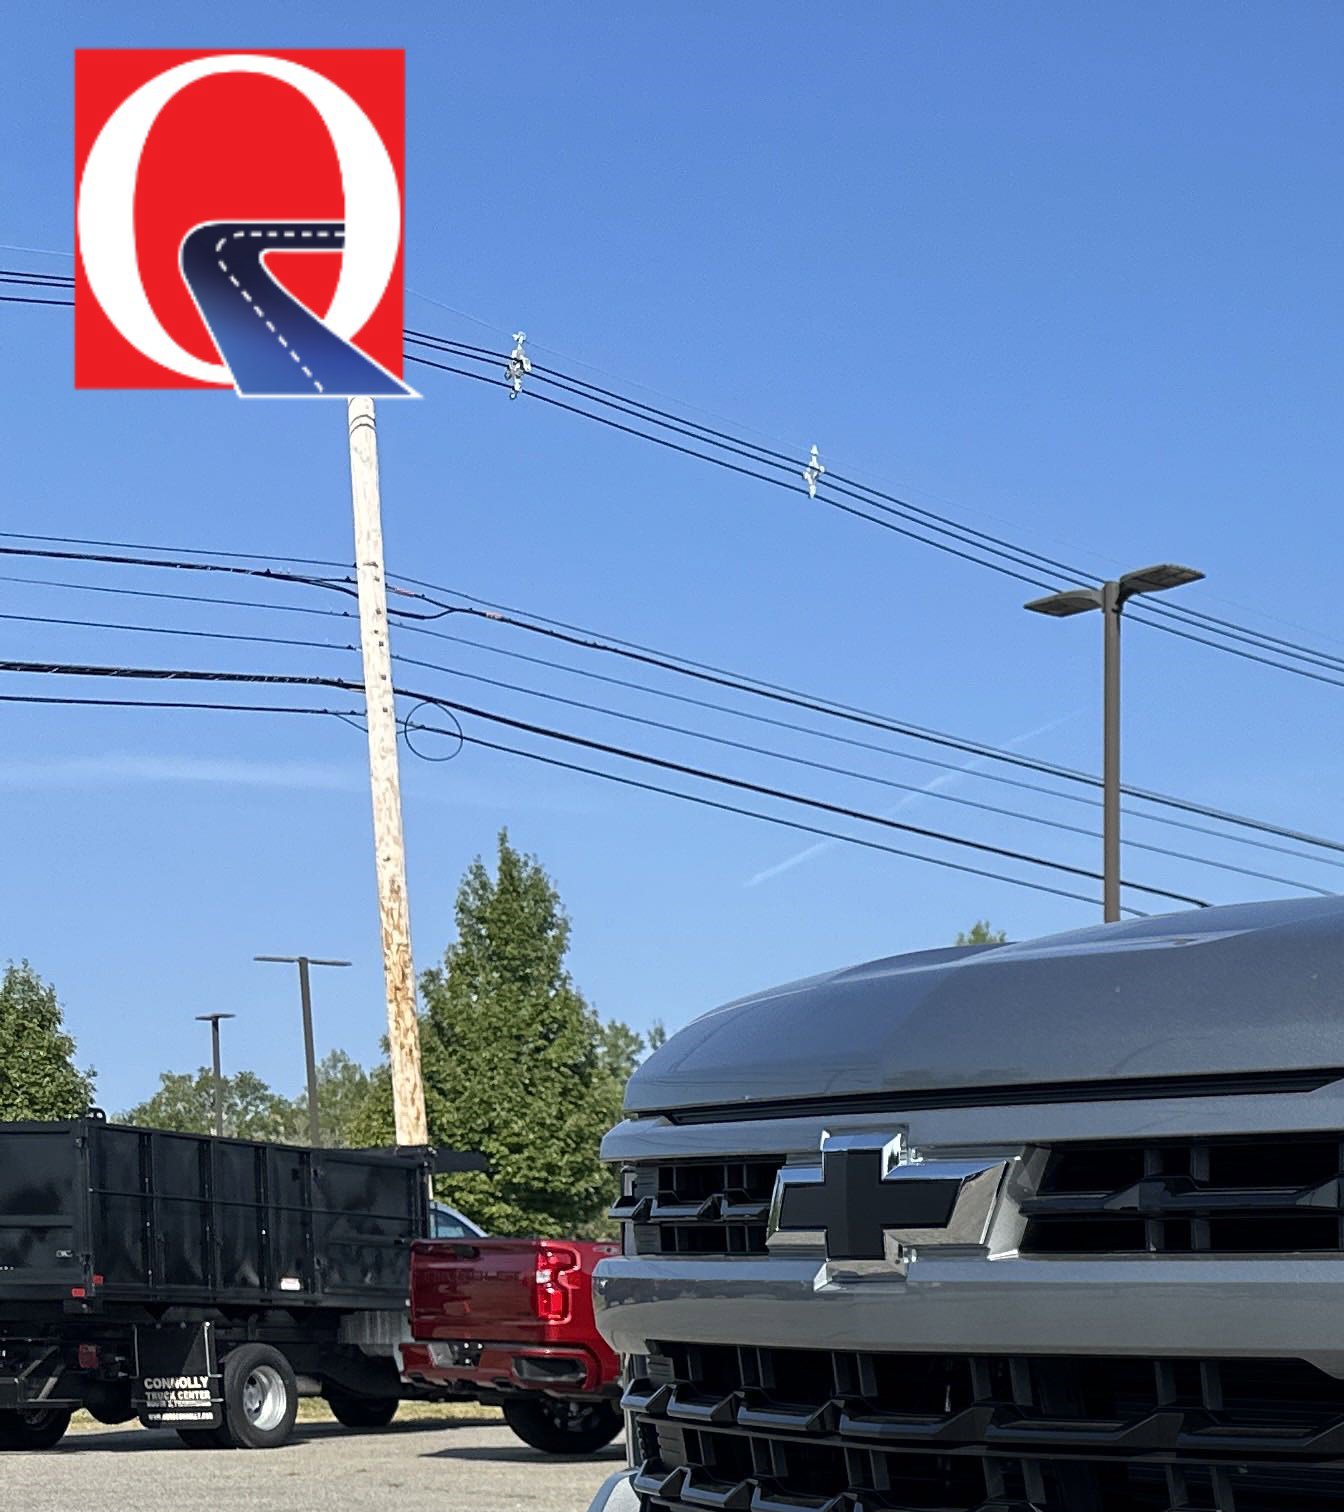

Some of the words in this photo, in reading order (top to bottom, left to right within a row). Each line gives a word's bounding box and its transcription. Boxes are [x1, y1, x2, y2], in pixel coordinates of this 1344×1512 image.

[143, 1376, 209, 1390] CONNOLLY
[144, 1390, 177, 1401] TRUCK
[177, 1389, 211, 1400] CENTER
